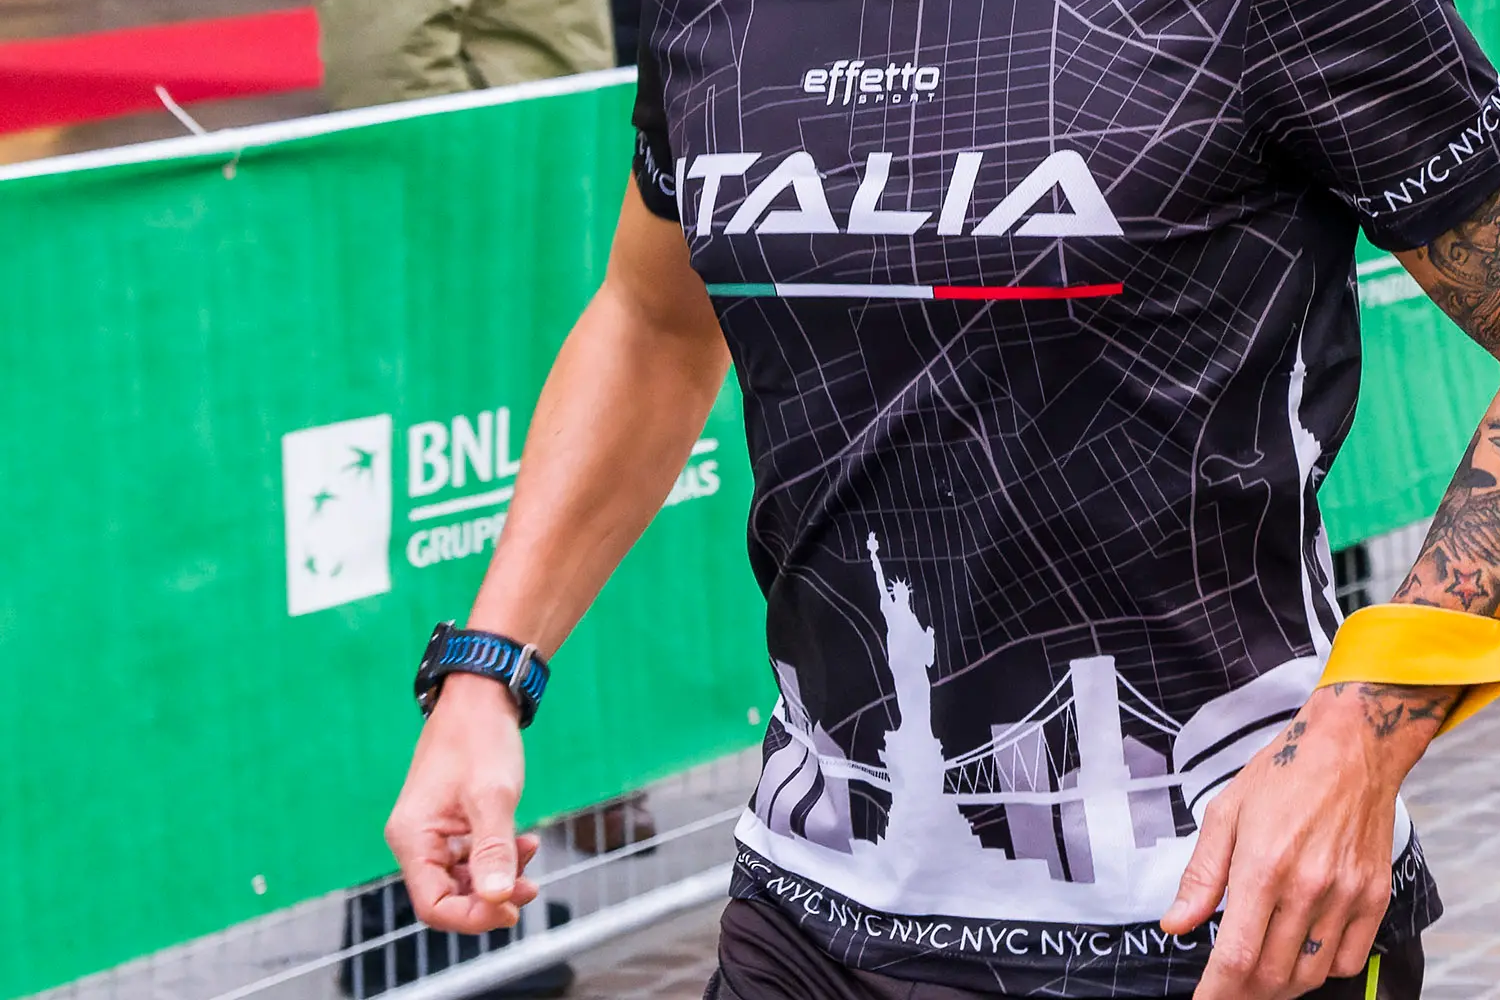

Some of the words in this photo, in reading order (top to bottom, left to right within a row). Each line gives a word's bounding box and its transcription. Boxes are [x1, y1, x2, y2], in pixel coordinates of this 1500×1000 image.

[803, 60, 940, 106] effetto
[858, 92, 936, 103] SPORT
[676, 149, 1125, 237] ITALIA
[1383, 155, 1450, 212] NYC
[1448, 104, 1500, 165] NYC
[407, 405, 521, 499] BNL
[766, 876, 823, 915] NYC
[828, 899, 882, 936] NYC
[889, 919, 952, 949] NYC
[959, 925, 1029, 955] NYC
[1041, 930, 1113, 956] NYC
